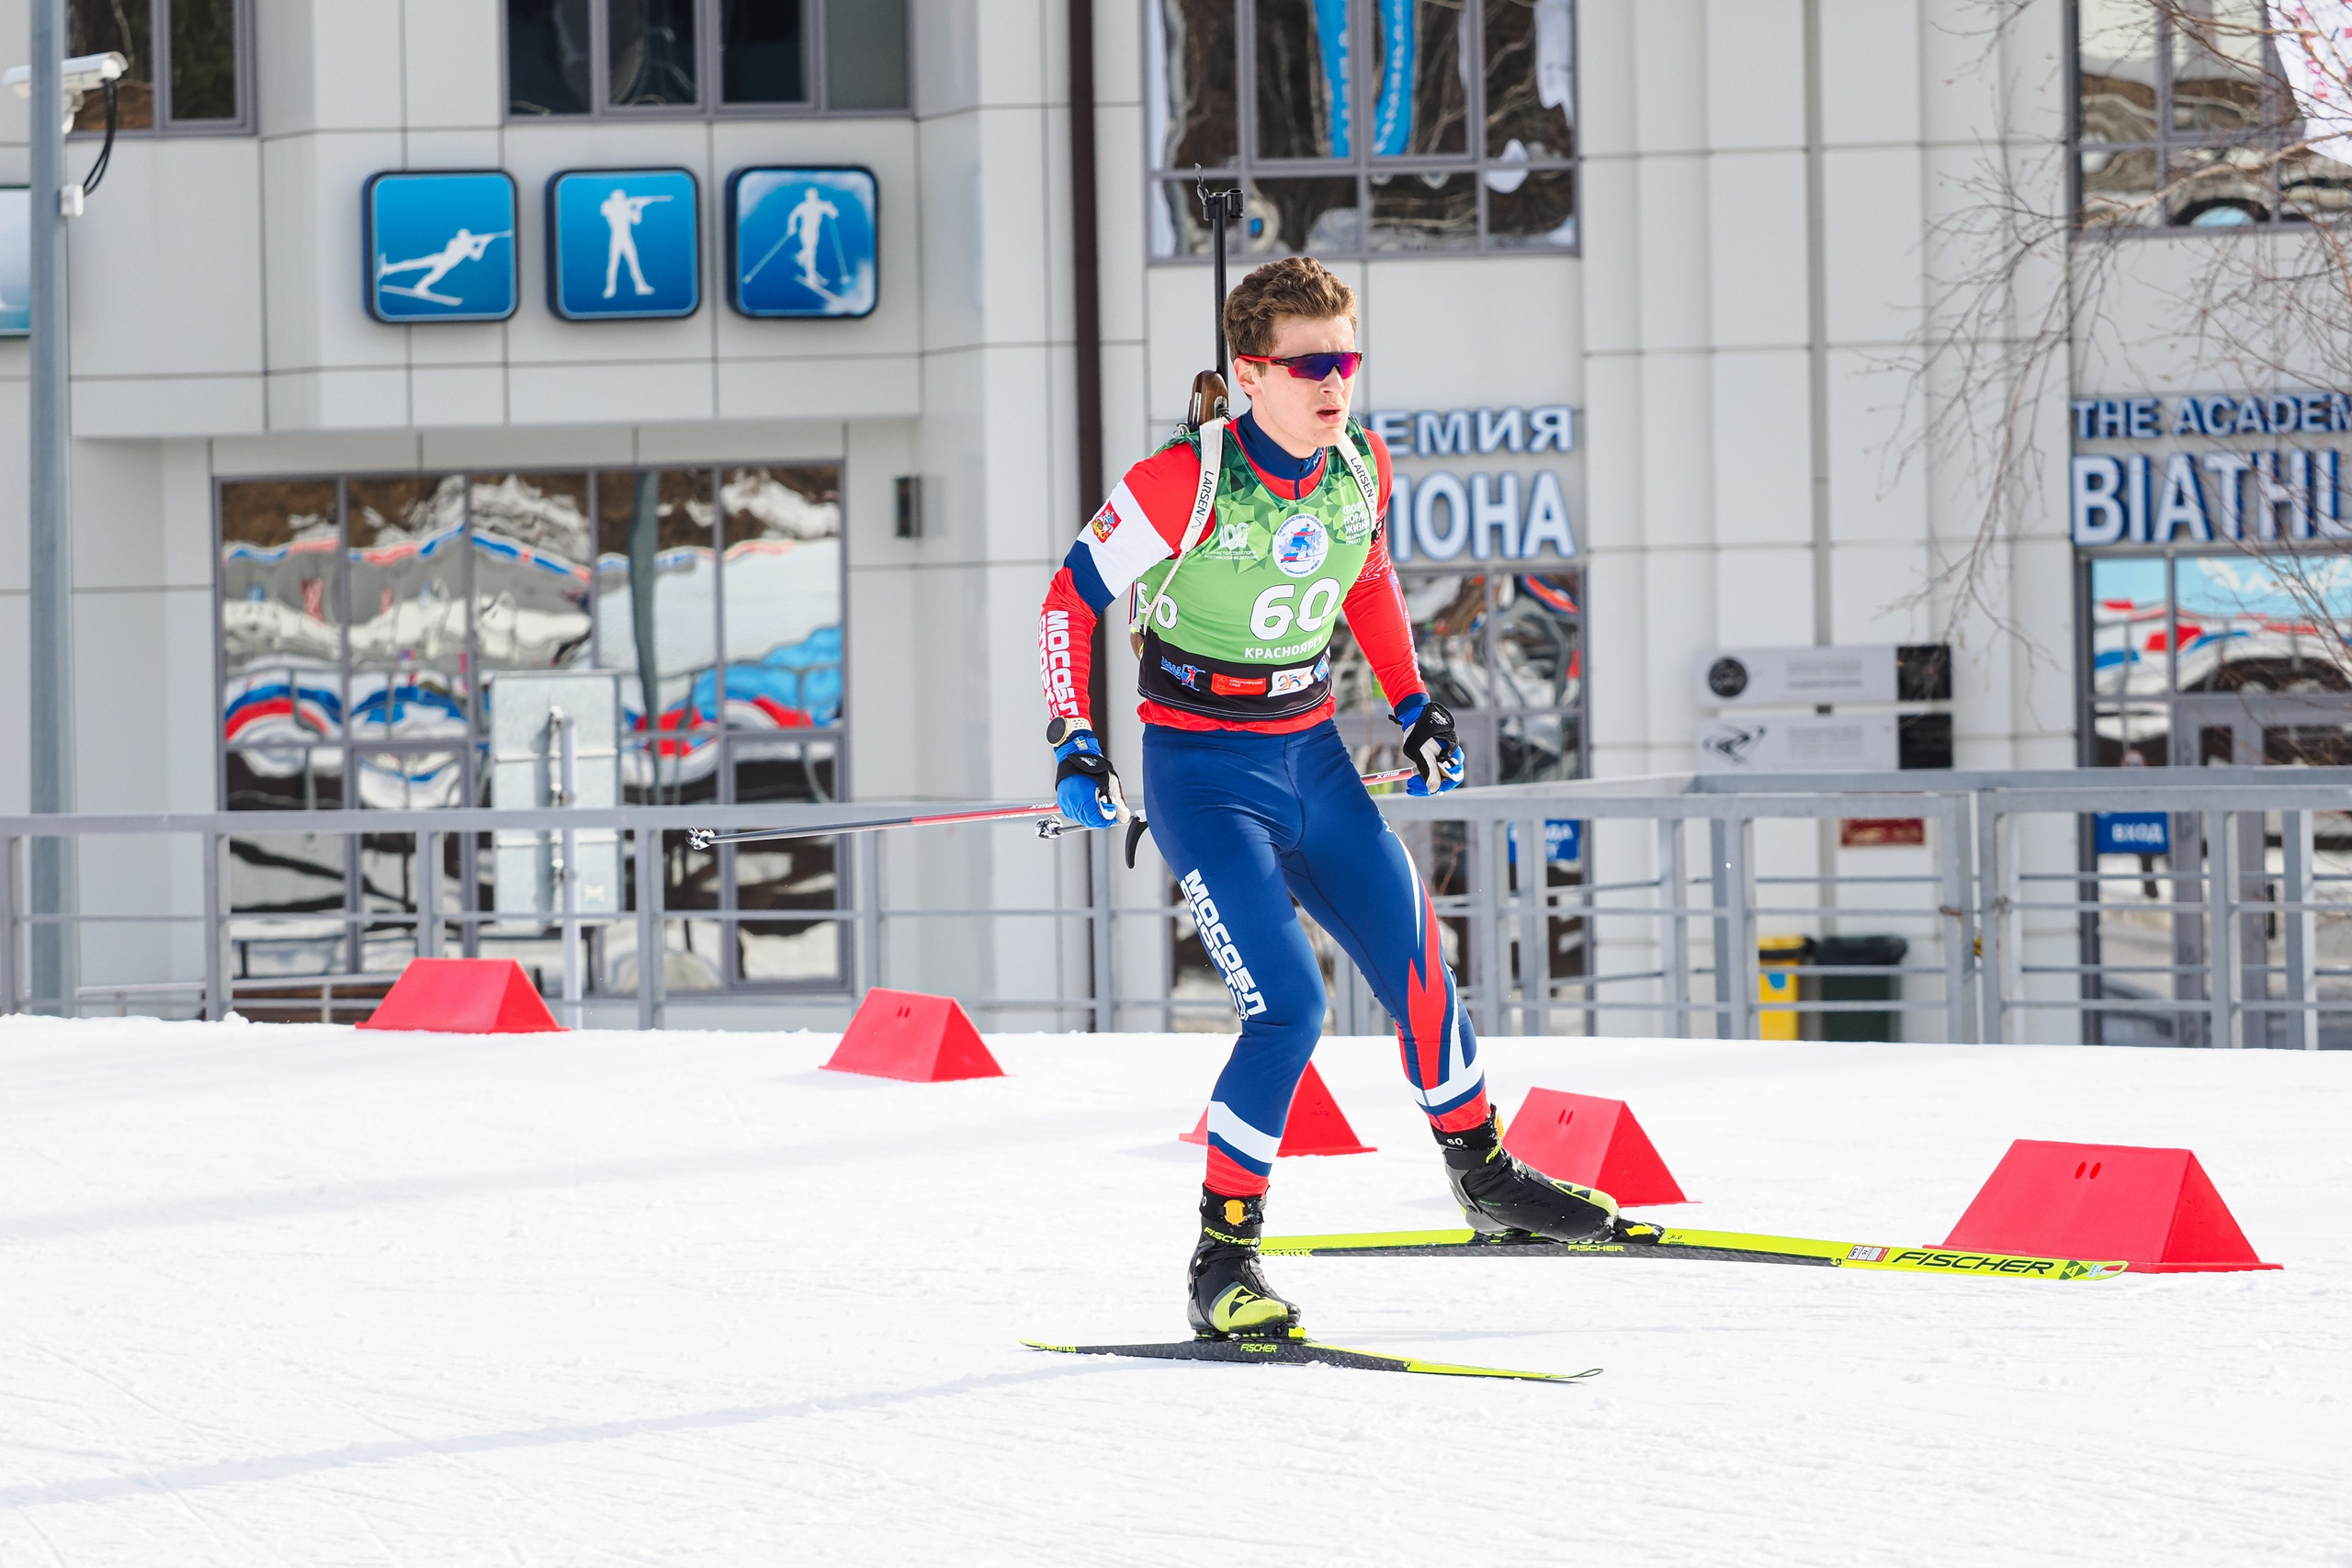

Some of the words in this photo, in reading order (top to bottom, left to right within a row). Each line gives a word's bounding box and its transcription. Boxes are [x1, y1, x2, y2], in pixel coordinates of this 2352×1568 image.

[1363, 405, 1574, 457] ЕМИЯ
[2071, 399, 2160, 439] THE
[1195, 470, 1215, 516] LARSEN
[1350, 457, 1374, 498] LARSEN
[1250, 577, 1341, 641] 60
[1047, 610, 1079, 716] МОСОБЛ
[1184, 868, 1268, 1016] МОСОБЛ
[1891, 1251, 2055, 1275] FISCHER
[1240, 1343, 1277, 1354] FISCHER
